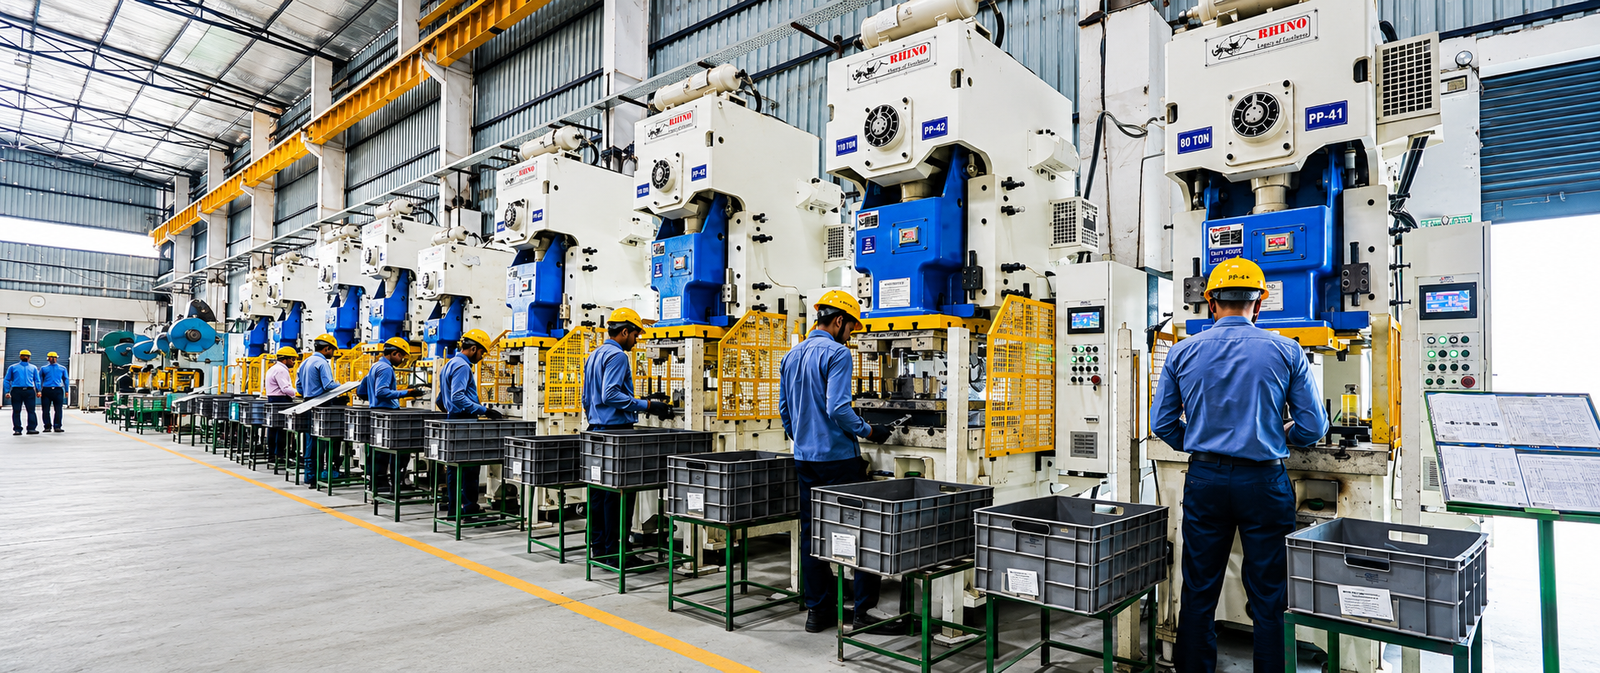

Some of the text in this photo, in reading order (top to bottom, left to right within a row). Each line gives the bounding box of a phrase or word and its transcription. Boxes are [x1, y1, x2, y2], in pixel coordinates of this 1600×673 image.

[1258, 17, 1307, 39] RHINO
[890, 44, 927, 64] RHINO
[669, 112, 692, 126] RHINO
[1308, 107, 1343, 125] PP-41
[924, 122, 946, 136] PP-42
[1180, 133, 1210, 148] 80 TON
